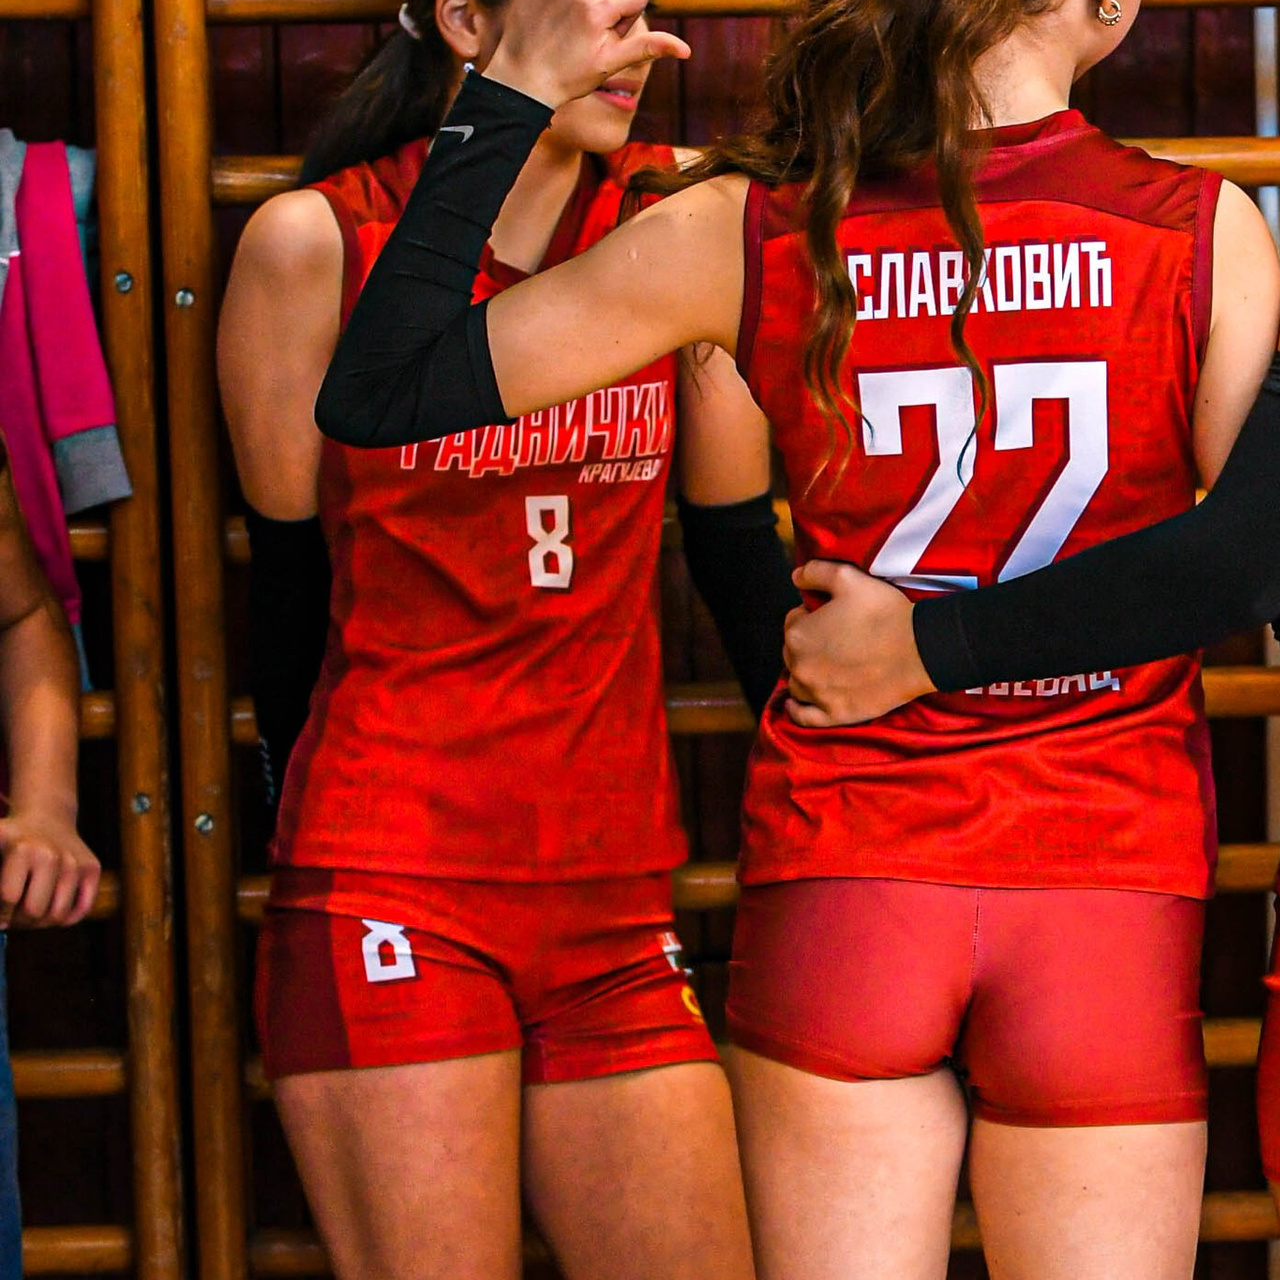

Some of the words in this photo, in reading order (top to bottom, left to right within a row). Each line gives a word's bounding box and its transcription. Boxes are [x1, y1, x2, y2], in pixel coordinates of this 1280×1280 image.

[847, 241, 1112, 320] СЛАВКОВИЋ
[858, 361, 1109, 592] 22
[524, 494, 574, 589] 8
